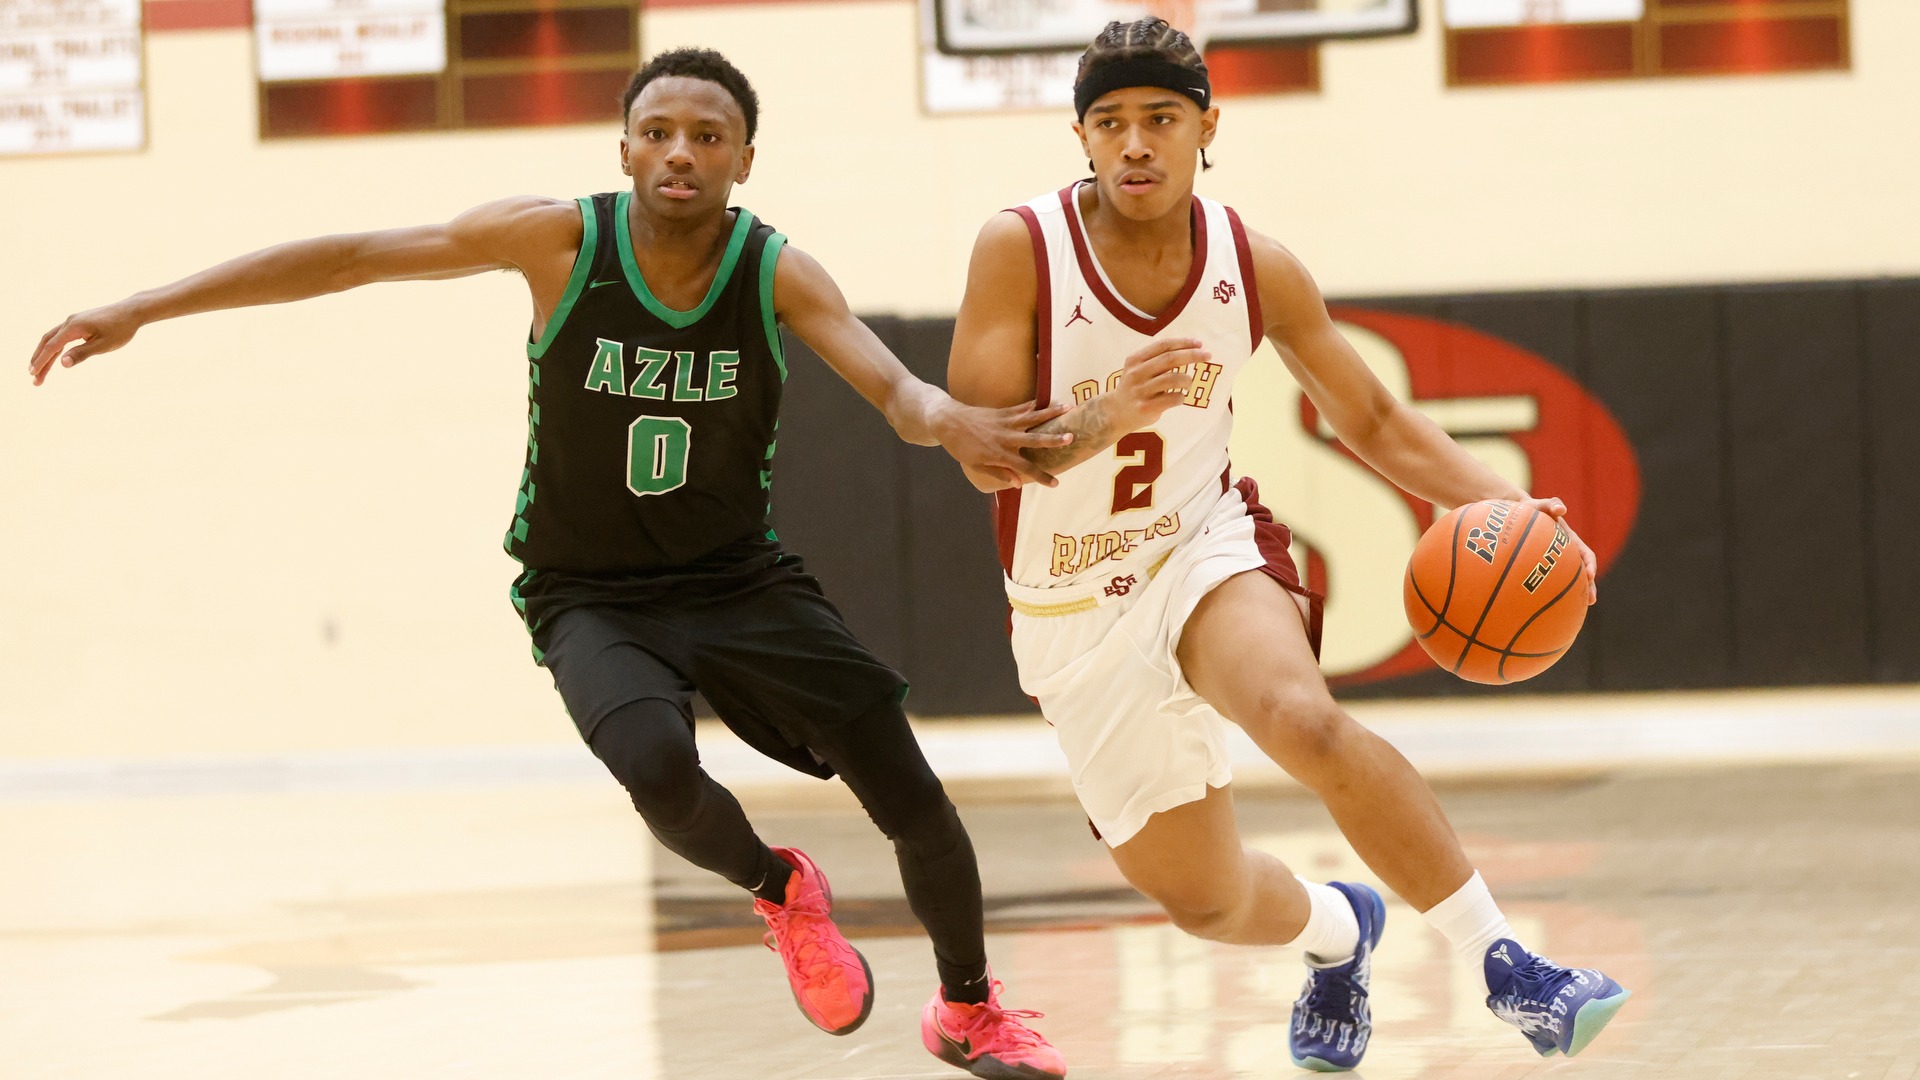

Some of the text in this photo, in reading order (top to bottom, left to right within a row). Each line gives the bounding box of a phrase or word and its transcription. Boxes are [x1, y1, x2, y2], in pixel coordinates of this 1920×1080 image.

[584, 337, 740, 402] AZLE
[626, 414, 692, 497] 0
[1111, 430, 1166, 517] 2
[1466, 500, 1512, 565] Bad
